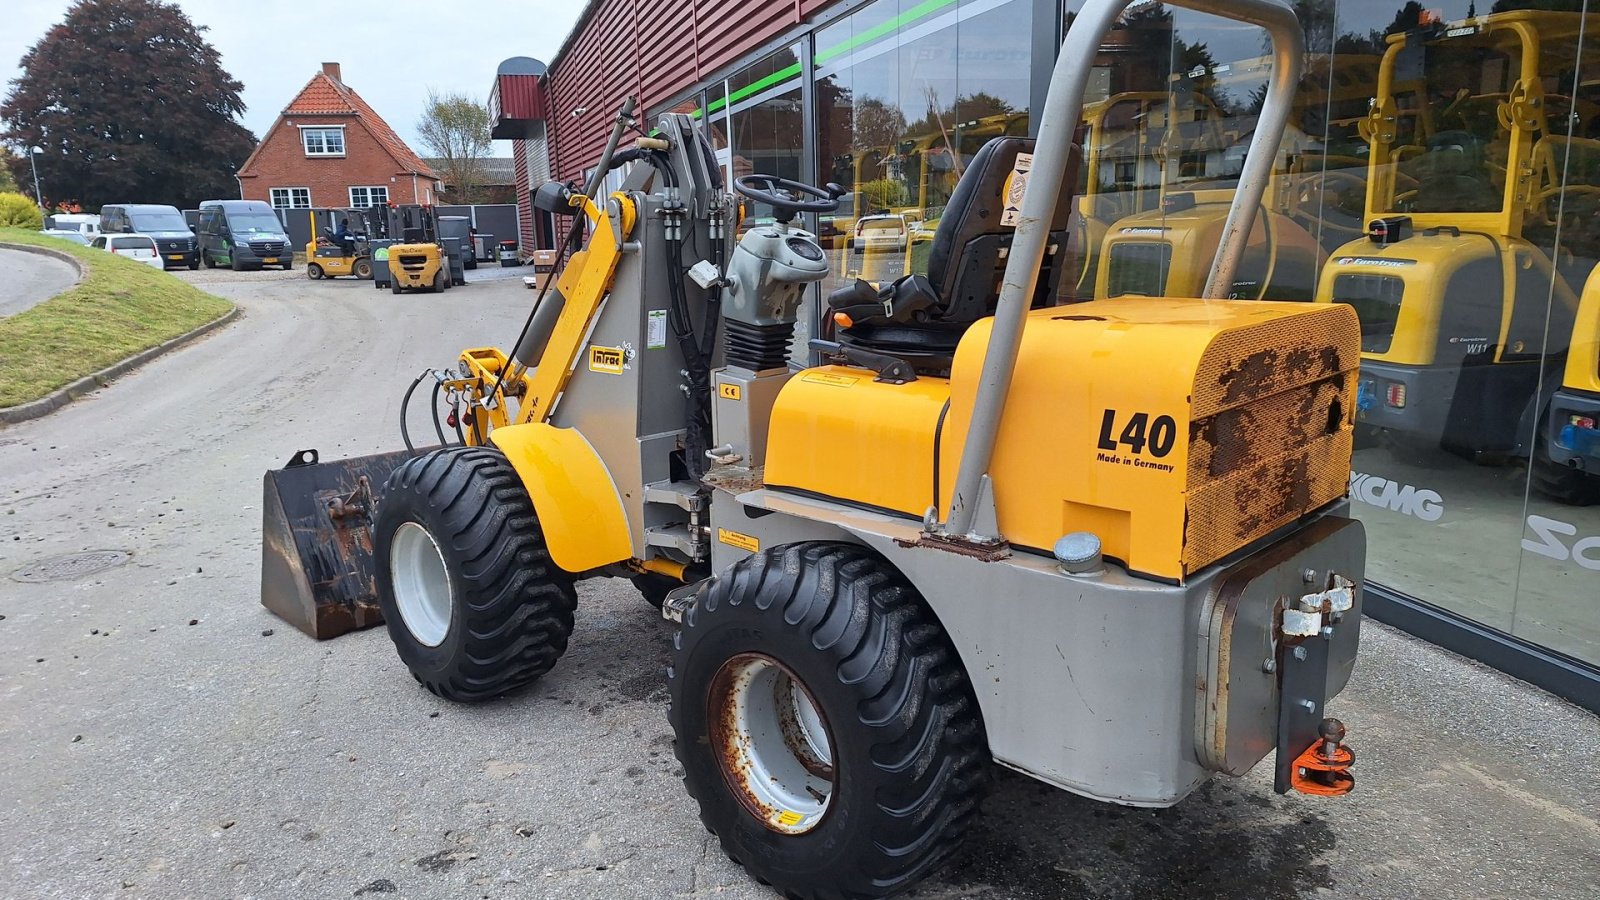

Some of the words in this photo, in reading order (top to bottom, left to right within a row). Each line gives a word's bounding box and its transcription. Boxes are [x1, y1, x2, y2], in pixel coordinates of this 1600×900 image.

[1353, 258, 1405, 267] Eurotrac
[1467, 343, 1488, 354] W11
[1097, 409, 1176, 458] L40
[1097, 453, 1120, 464] Made
[1123, 456, 1131, 465] in
[1134, 458, 1174, 473] Germany
[1349, 470, 1444, 522] XCMG
